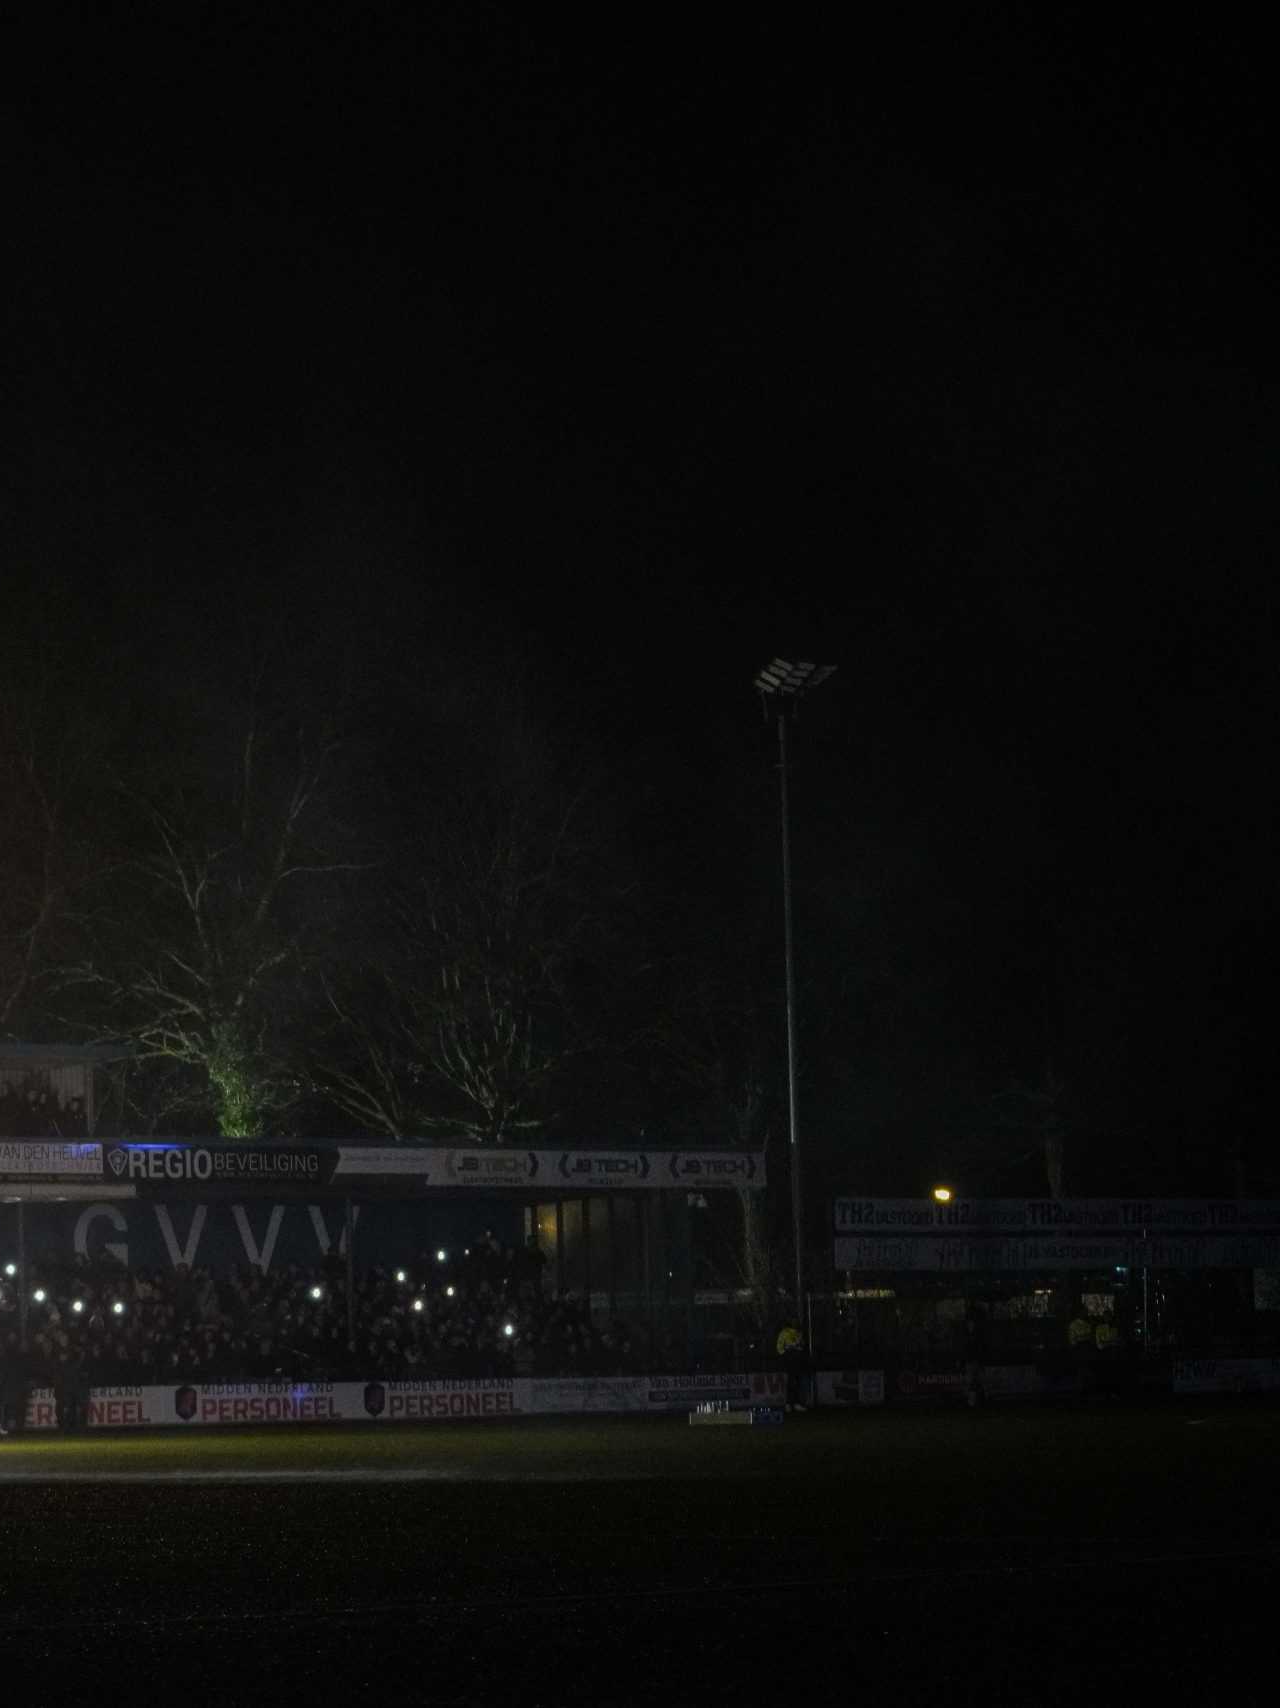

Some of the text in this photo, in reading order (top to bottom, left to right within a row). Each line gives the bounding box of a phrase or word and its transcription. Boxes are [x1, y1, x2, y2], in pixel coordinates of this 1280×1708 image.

[23, 1145, 50, 1161] DEN
[127, 1148, 213, 1180] REGIO
[214, 1152, 319, 1172] BEVEILIGING
[201, 1396, 342, 1422] PERSONEEL
